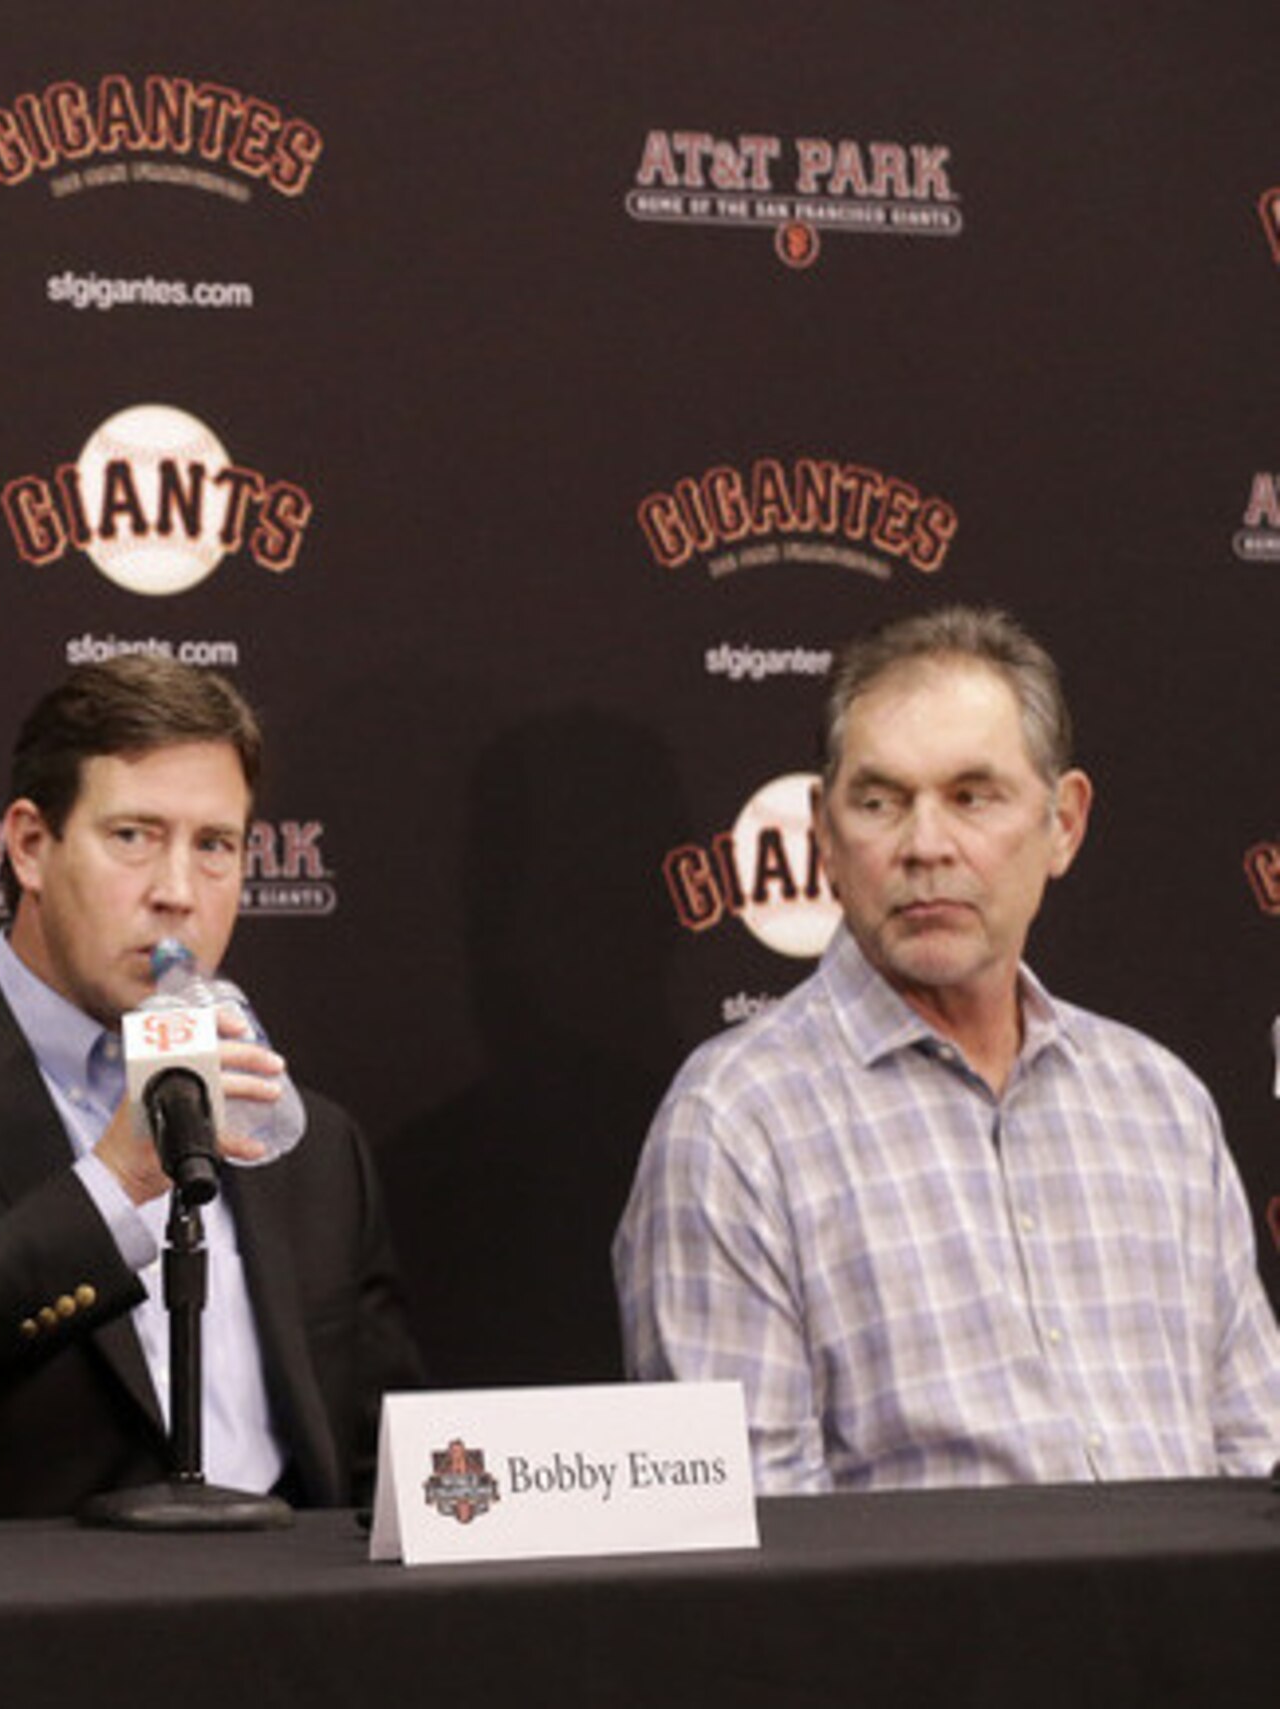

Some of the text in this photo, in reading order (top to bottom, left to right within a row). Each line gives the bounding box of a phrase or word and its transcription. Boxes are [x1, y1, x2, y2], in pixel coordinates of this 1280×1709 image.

[636, 130, 952, 201] AT&T PARK
[636, 196, 683, 216] HOME
[719, 200, 748, 219] THE
[755, 202, 789, 220] SAN
[891, 208, 952, 228] GIANTS
[47, 270, 253, 310] sfgigantes.com
[0, 456, 313, 574] GIANTS
[637, 456, 958, 573] GIGANTES
[507, 1452, 617, 1503] Bobby
[627, 1451, 727, 1489] Evans
